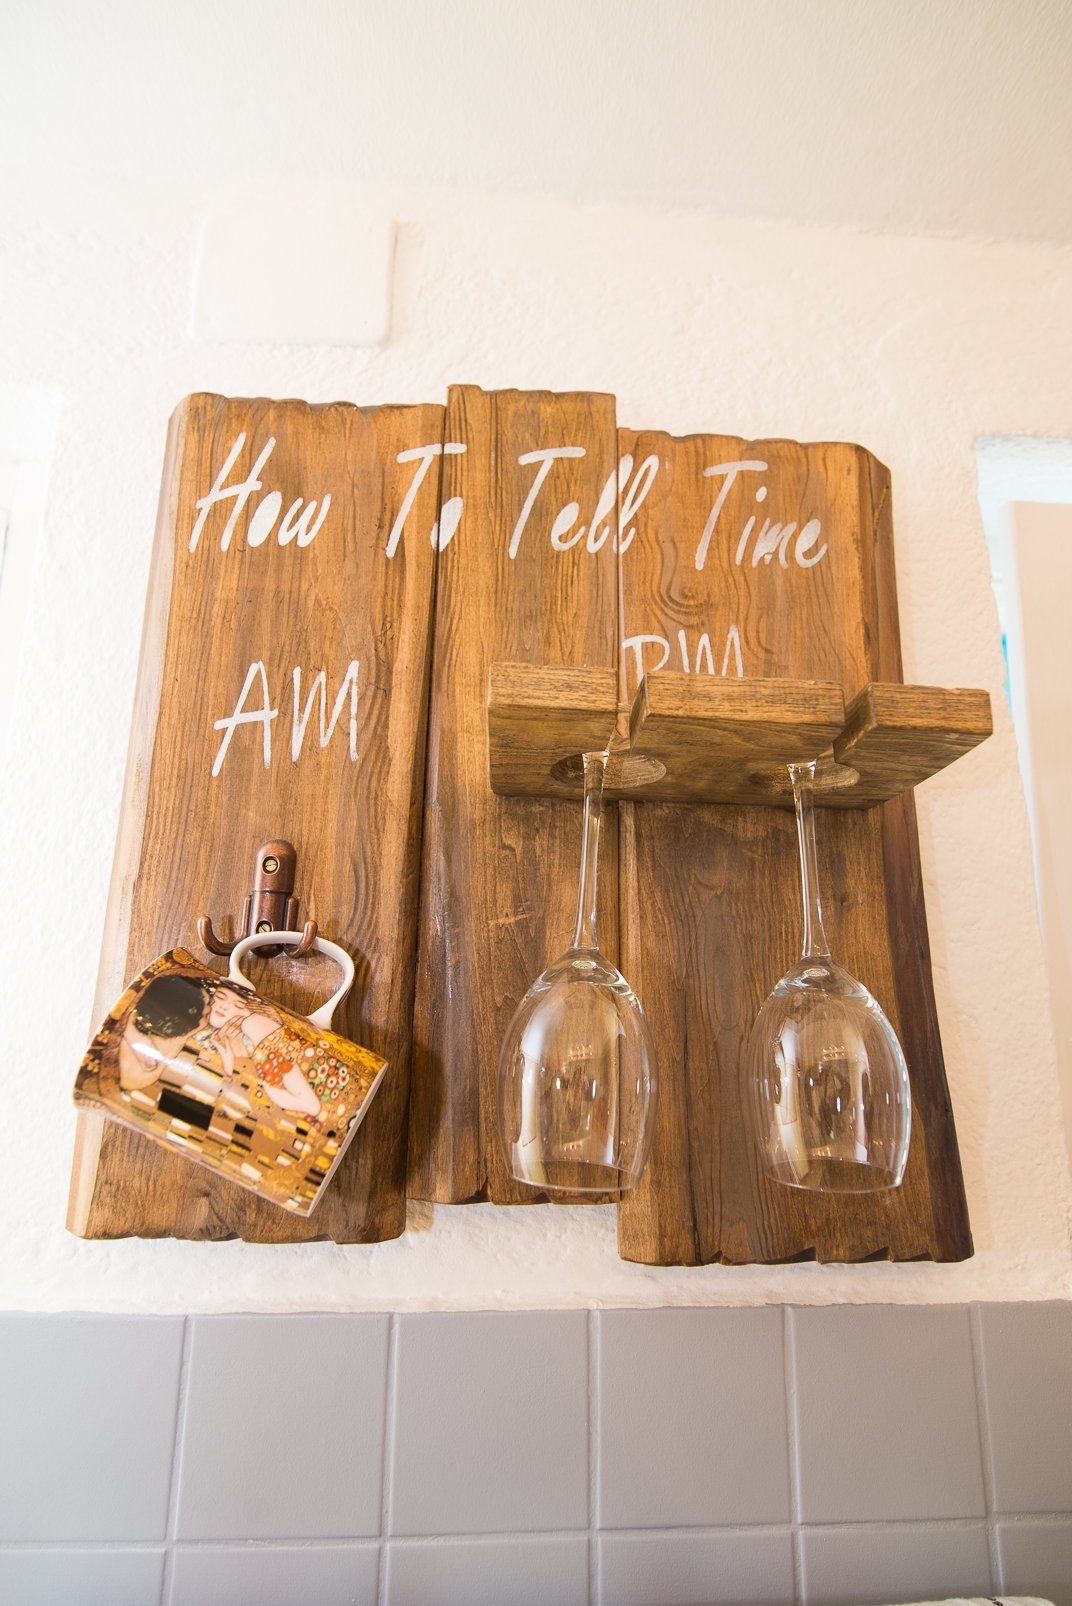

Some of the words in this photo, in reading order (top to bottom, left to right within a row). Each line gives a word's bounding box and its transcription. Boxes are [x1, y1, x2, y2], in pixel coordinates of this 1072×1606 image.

[189, 431, 331, 552] How
[385, 442, 467, 559] To
[508, 446, 659, 559] Tell
[695, 460, 828, 570] Time
[211, 660, 359, 777] AM
